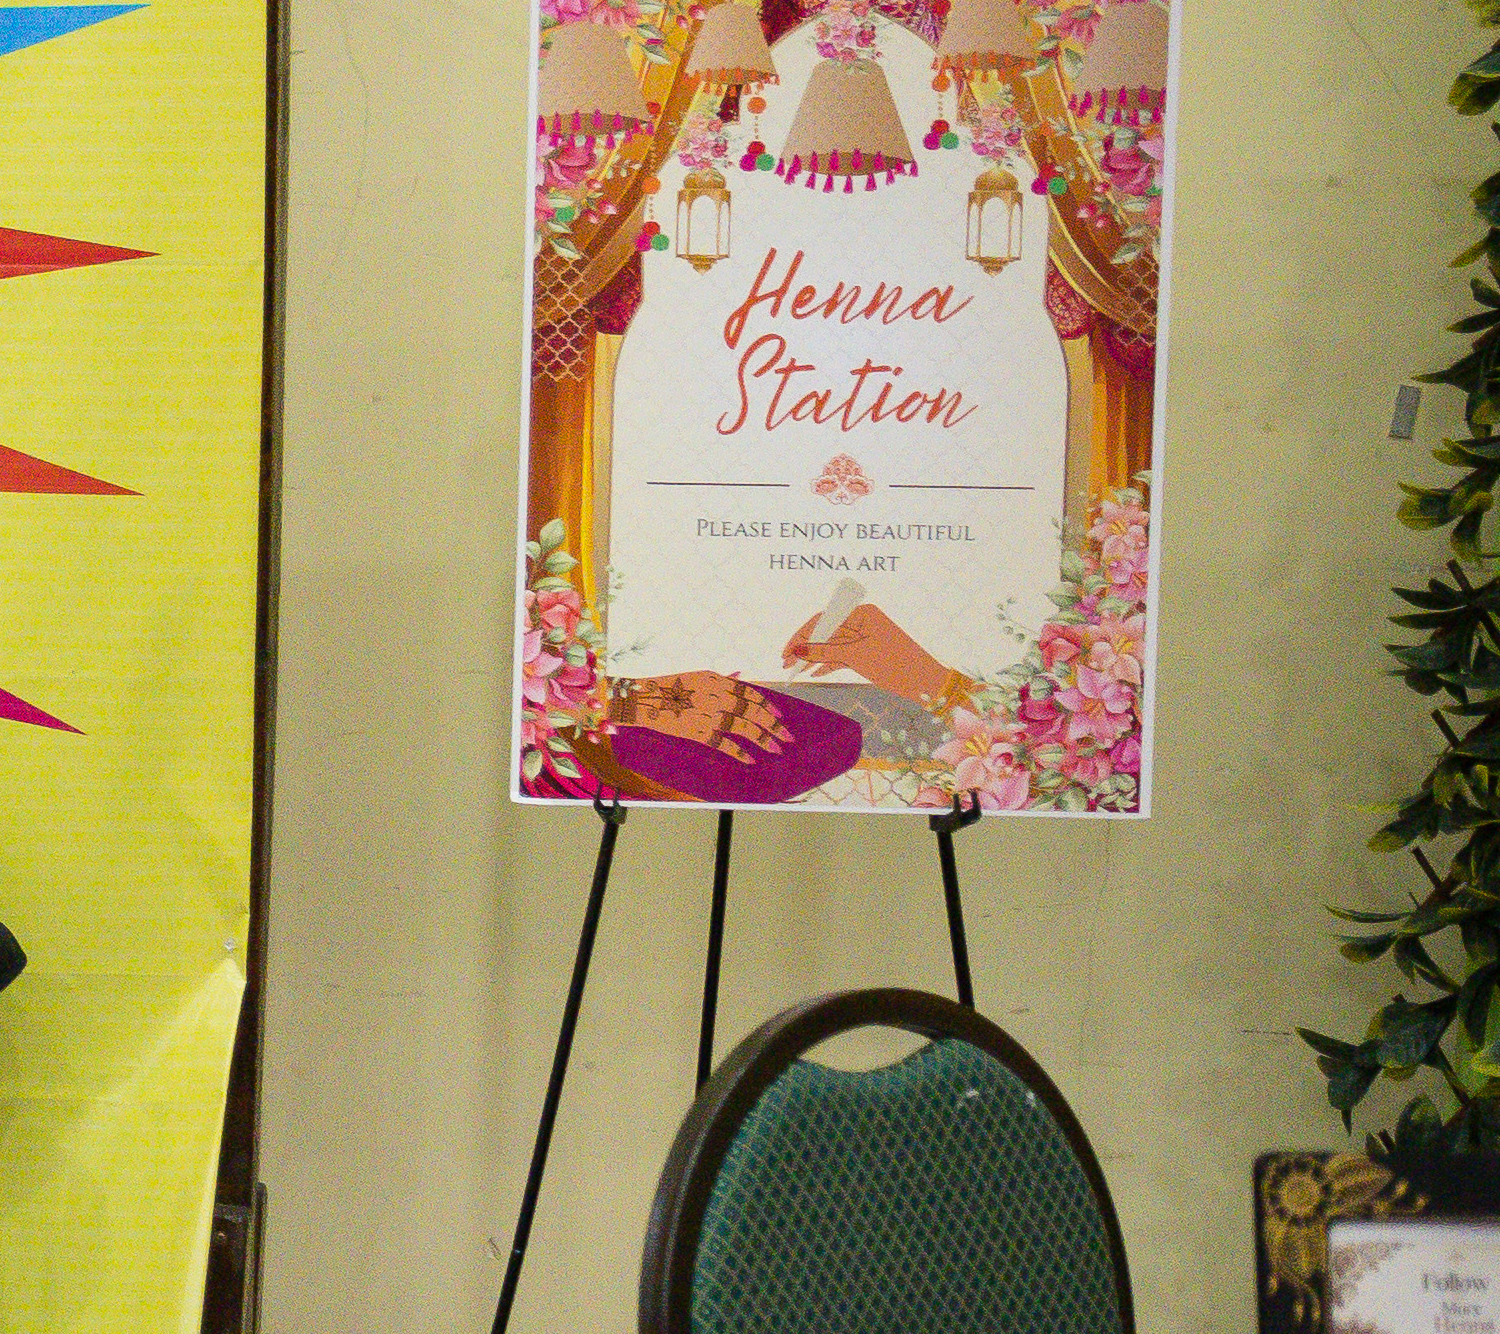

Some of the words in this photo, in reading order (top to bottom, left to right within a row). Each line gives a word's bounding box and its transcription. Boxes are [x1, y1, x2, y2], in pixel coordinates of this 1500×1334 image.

[723, 247, 976, 350] Henna
[716, 333, 979, 436] Station
[696, 518, 772, 538] PLEASE
[780, 522, 847, 542] ENJOY
[856, 523, 976, 542] BEAUTIFUL
[769, 554, 850, 572] HENNA
[856, 555, 901, 572] ART
